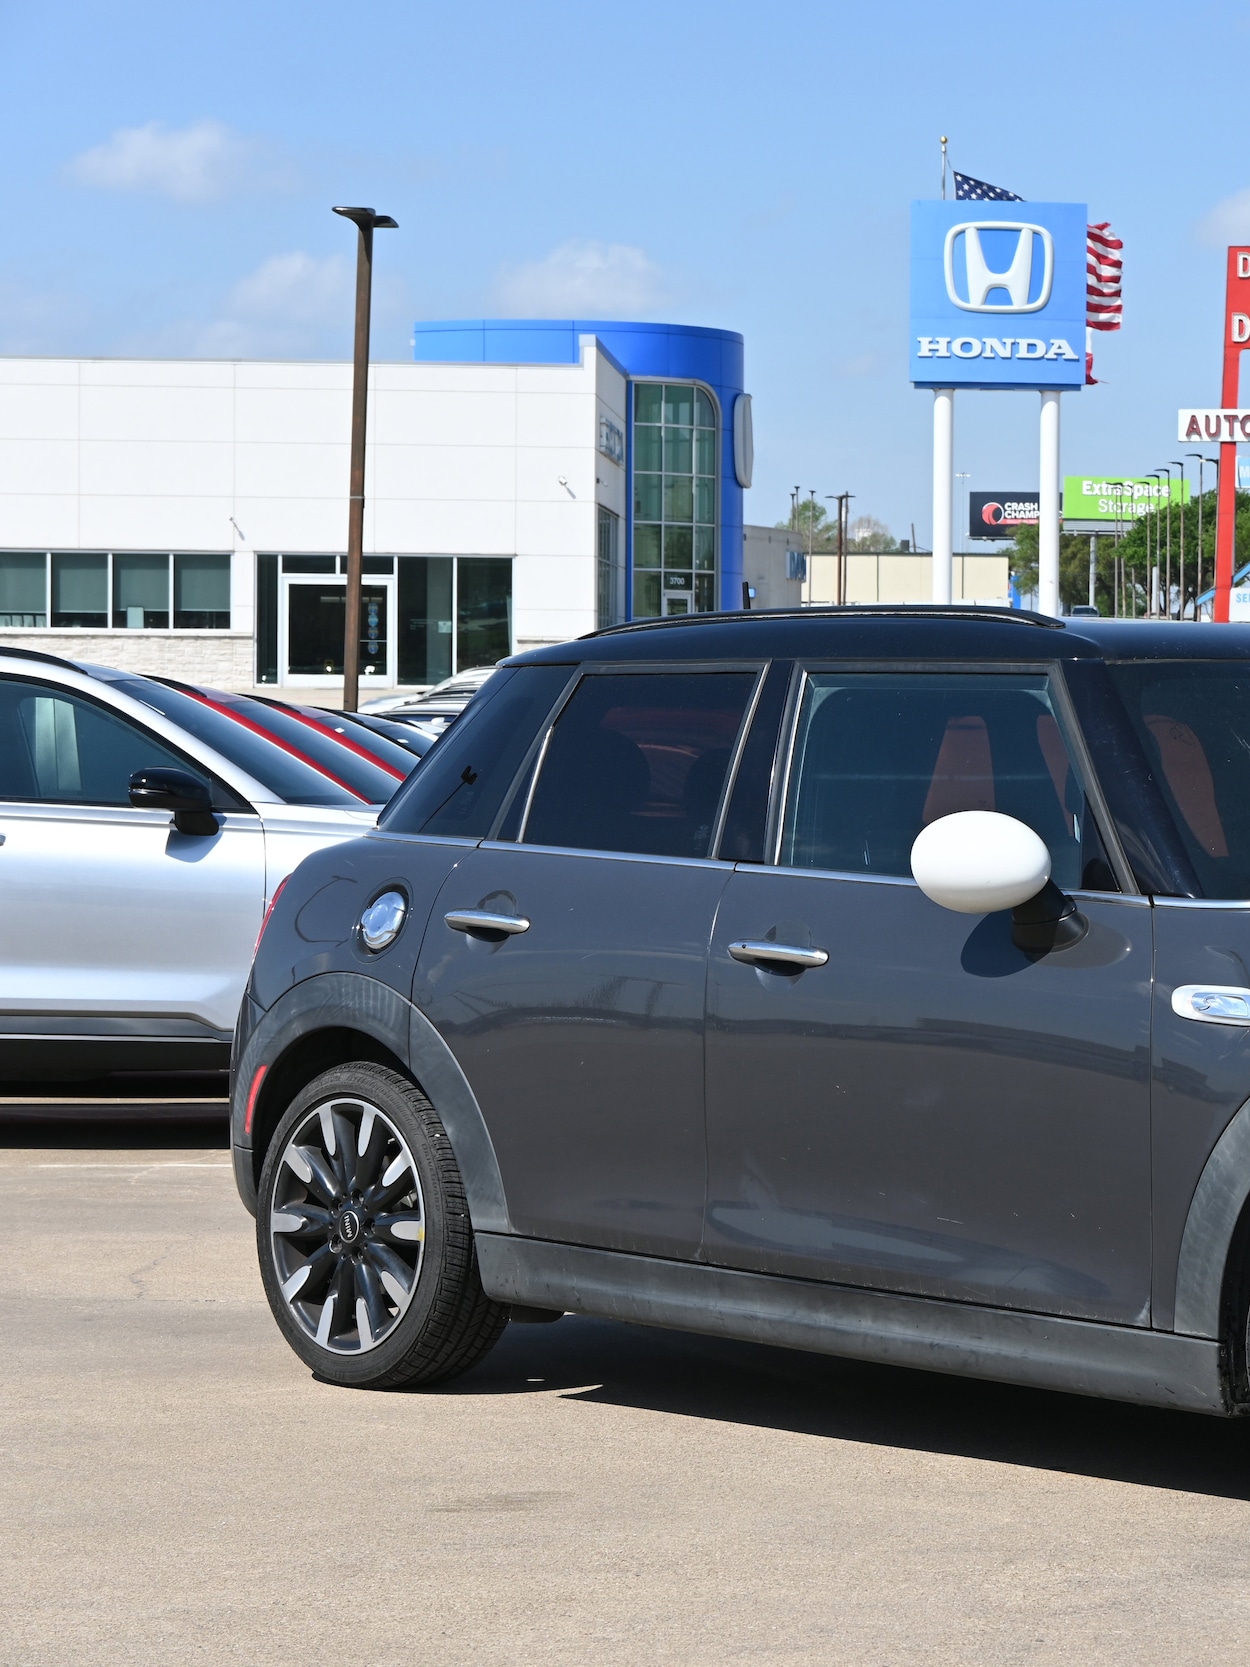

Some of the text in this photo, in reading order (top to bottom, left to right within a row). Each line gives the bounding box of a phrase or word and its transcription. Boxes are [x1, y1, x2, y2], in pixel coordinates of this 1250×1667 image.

[917, 337, 1079, 361] HONDA
[1004, 502, 1038, 511] CRASH
[1098, 499, 1154, 516] Storage
[669, 576, 685, 585] 3700
[344, 1215, 353, 1238] MINI
